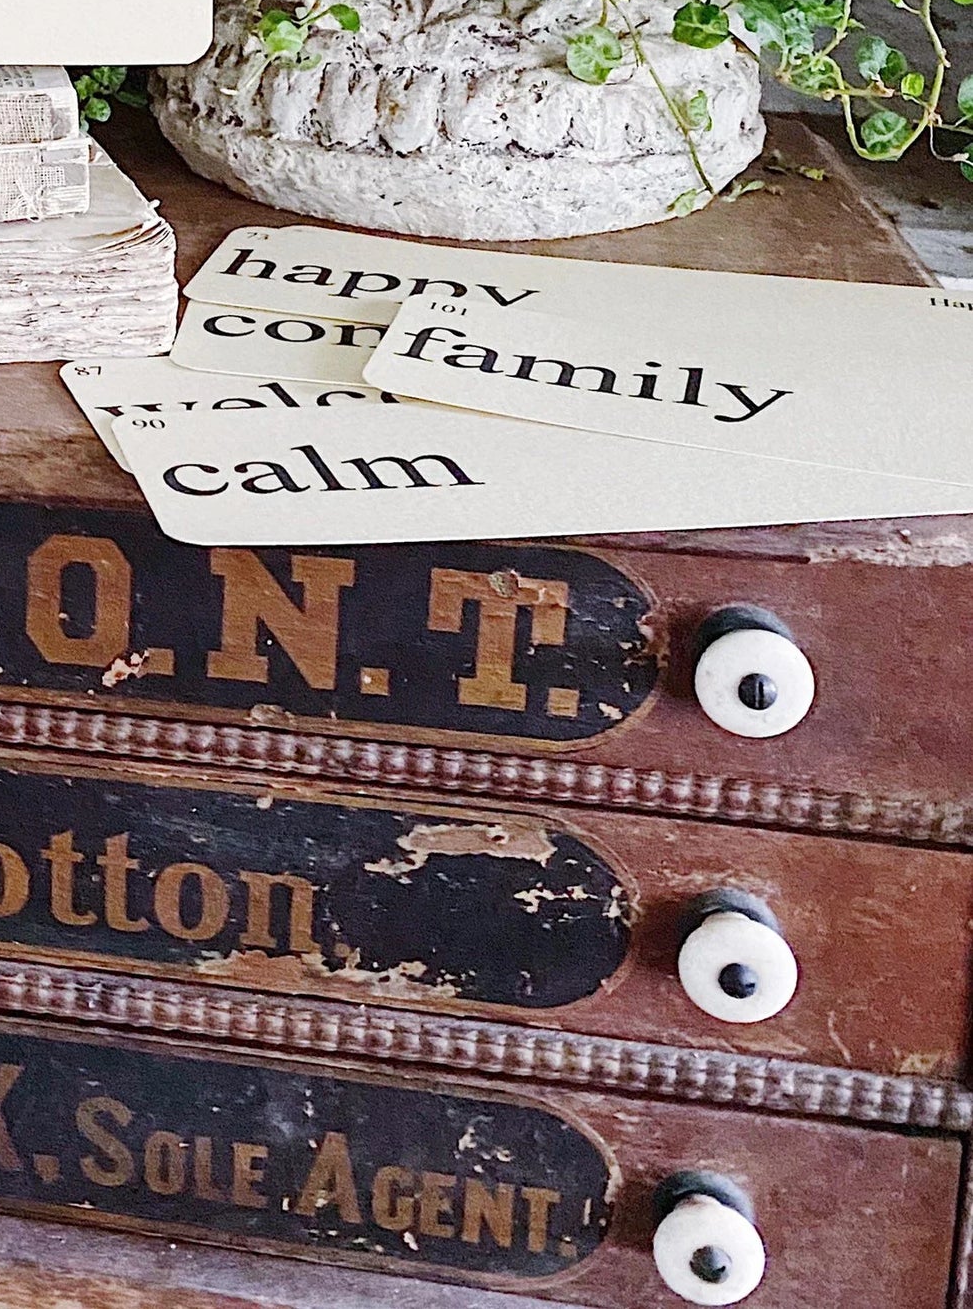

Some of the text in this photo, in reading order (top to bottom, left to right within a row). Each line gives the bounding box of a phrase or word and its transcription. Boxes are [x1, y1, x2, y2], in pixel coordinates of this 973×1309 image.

[430, 302, 468, 316] 101
[74, 365, 103, 377] 87
[393, 326, 794, 423] family
[132, 418, 166, 430] 90
[162, 444, 486, 496] calm
